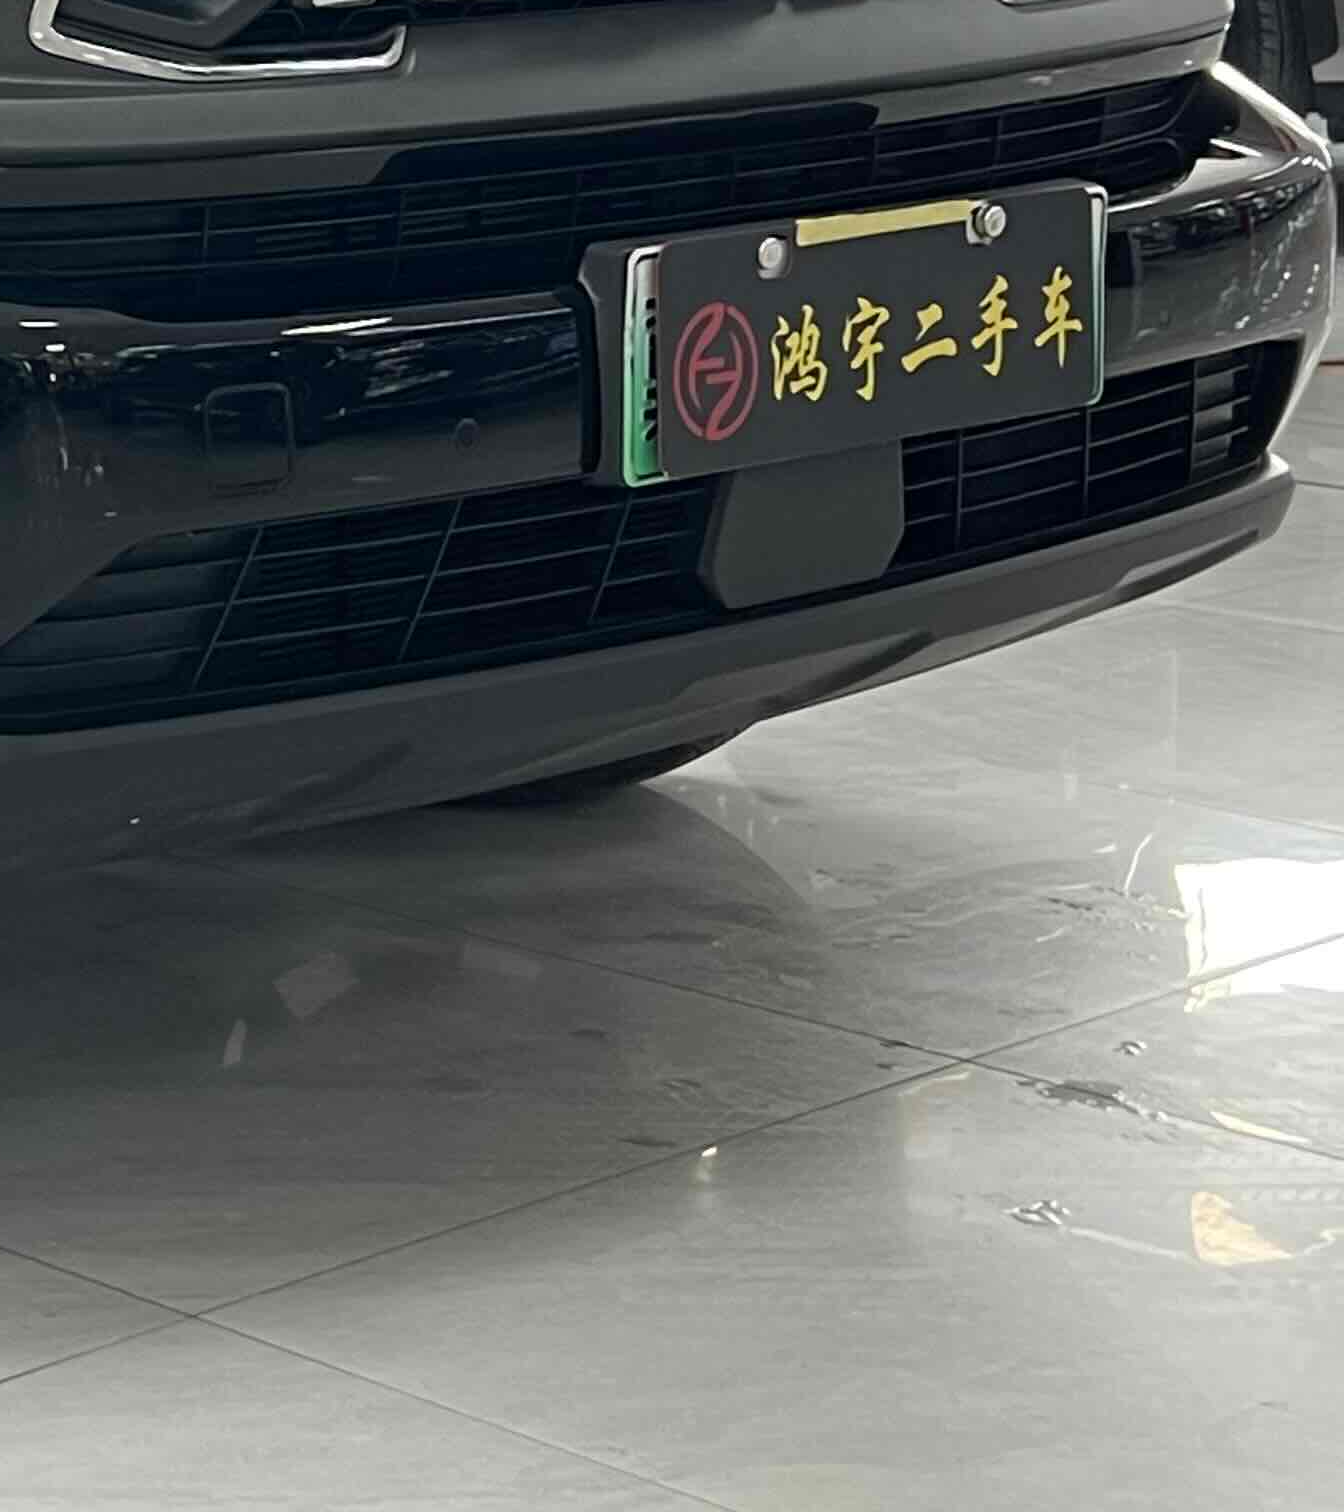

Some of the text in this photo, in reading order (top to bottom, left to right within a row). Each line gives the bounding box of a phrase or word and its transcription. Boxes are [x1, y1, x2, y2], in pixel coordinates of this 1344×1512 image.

[769, 265, 1084, 402] 鸿宇二手车
